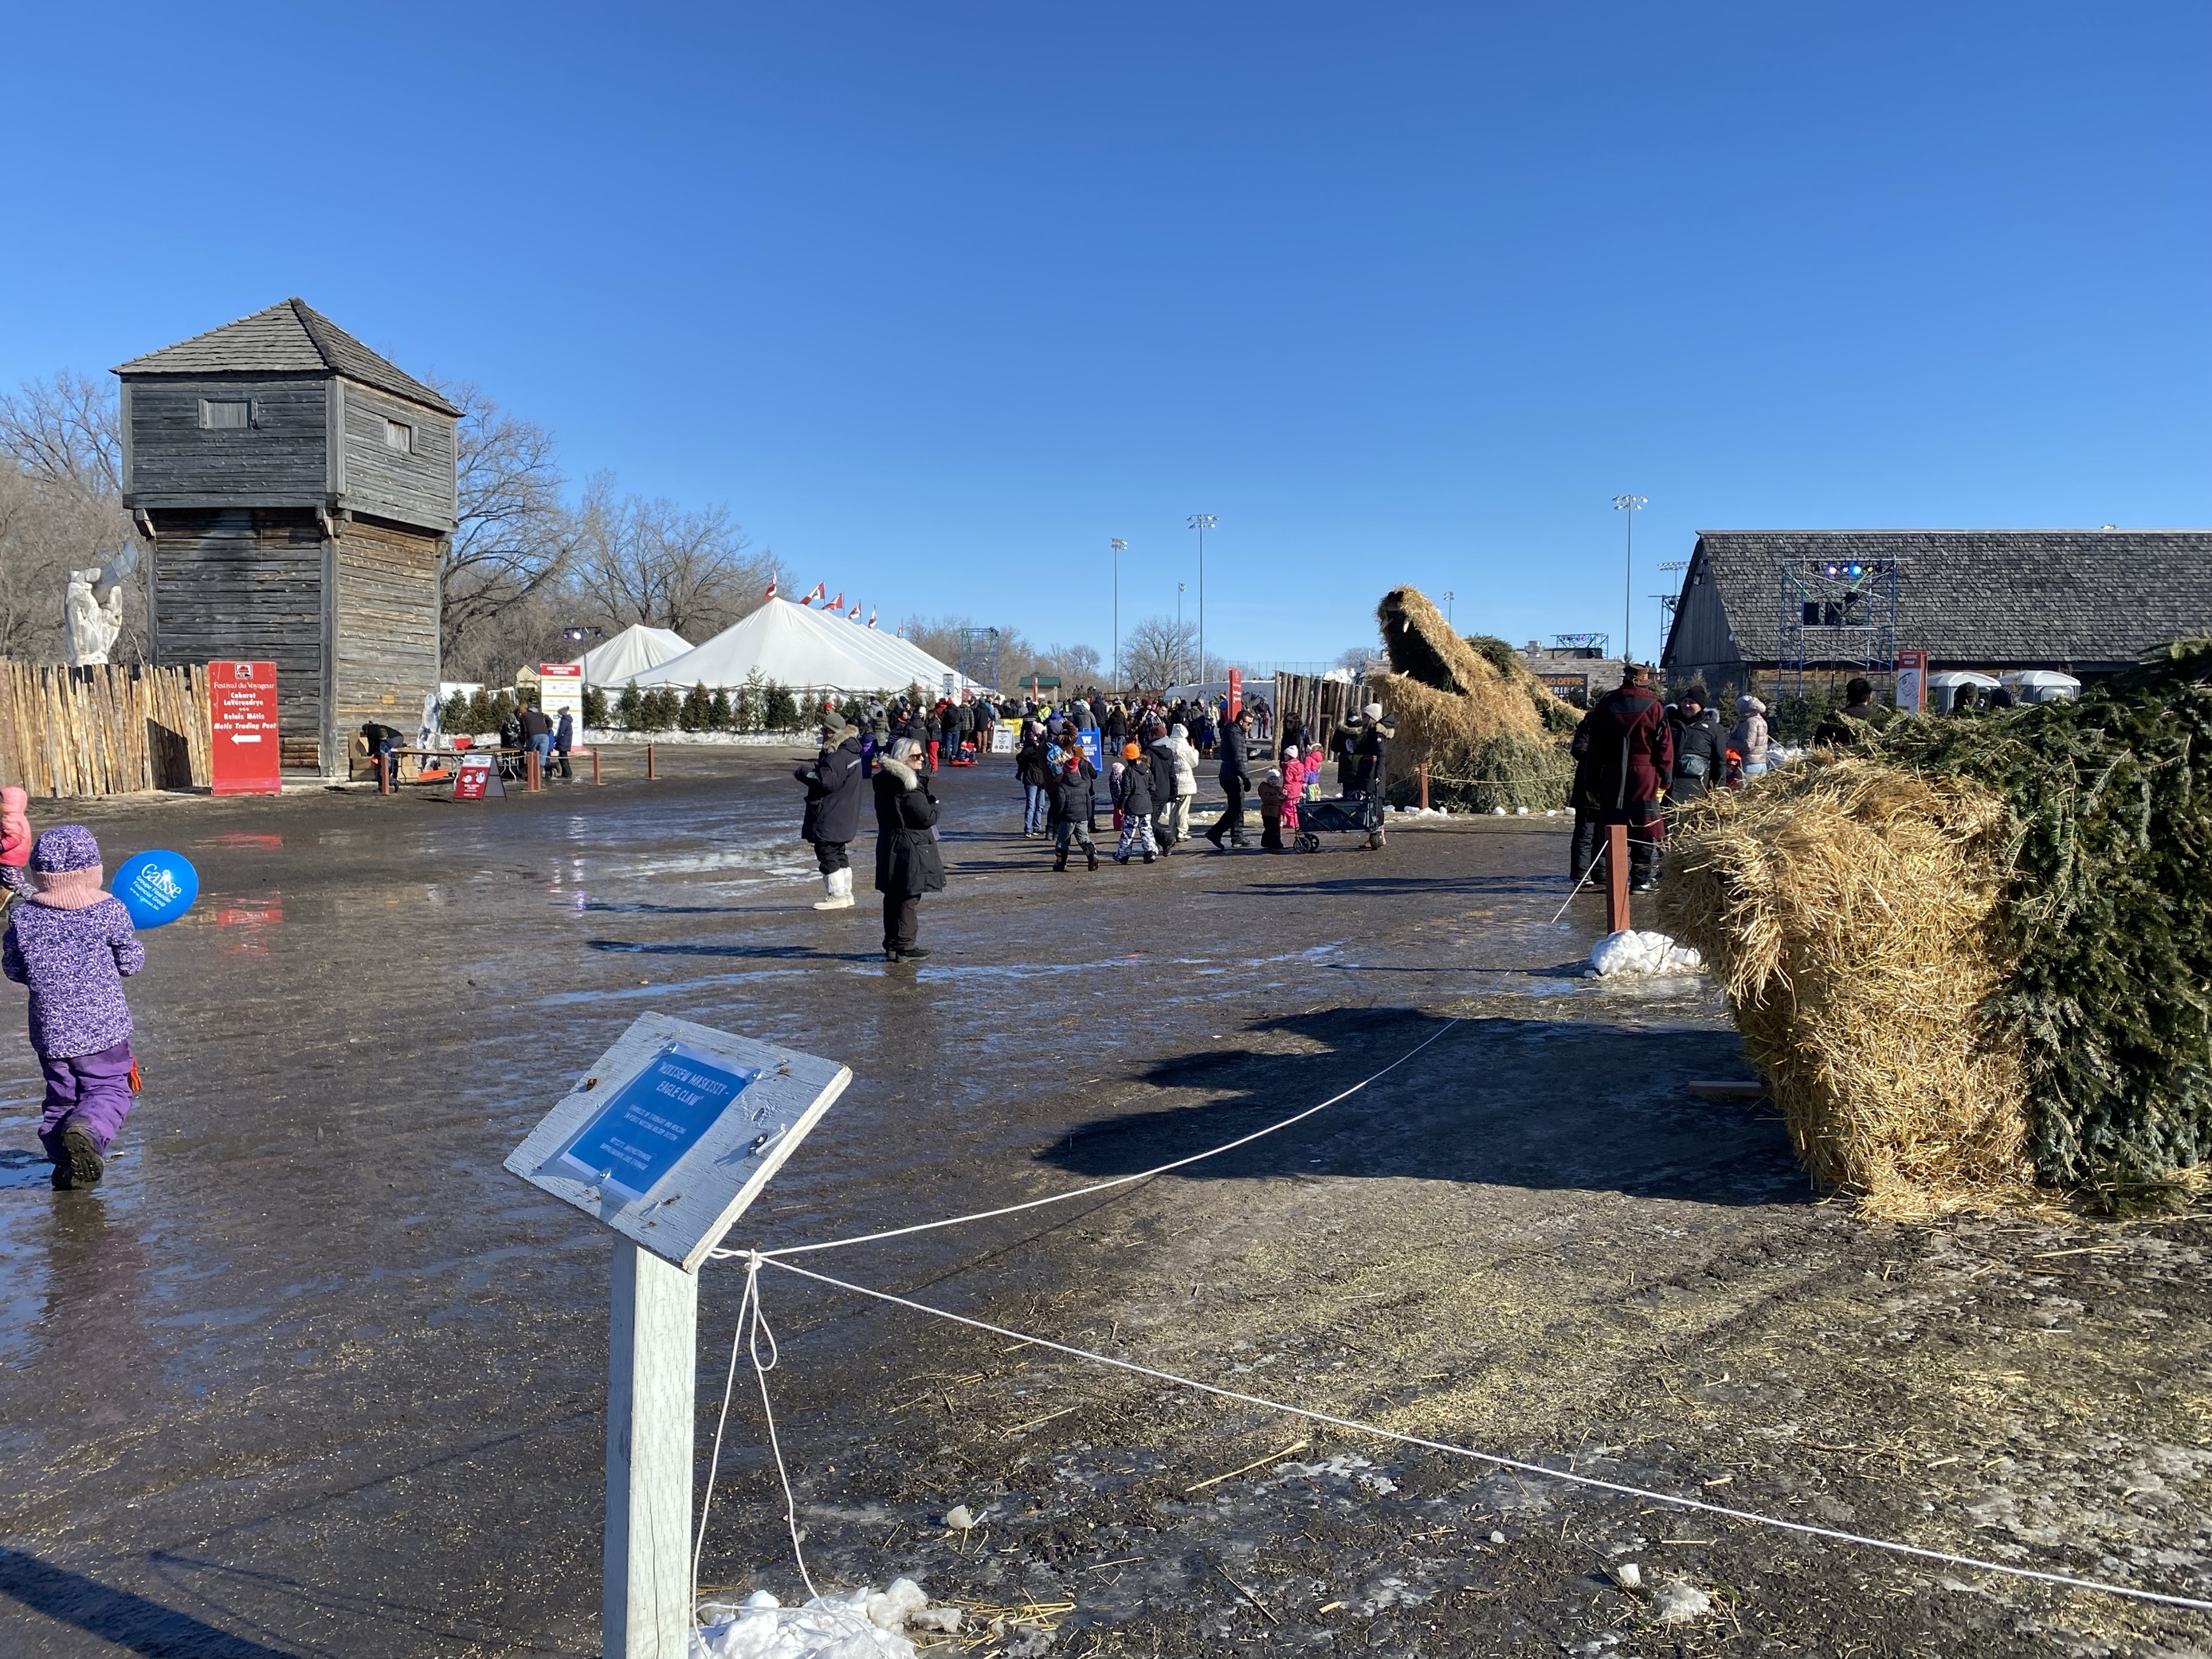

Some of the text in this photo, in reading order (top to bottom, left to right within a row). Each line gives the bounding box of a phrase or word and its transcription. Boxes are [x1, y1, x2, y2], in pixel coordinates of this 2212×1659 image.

[133, 880, 166, 907] Financial Group
[136, 876, 171, 903] Groupe Financier
[142, 864, 182, 898] Caisse
[656, 1081, 681, 1098] EAGLE
